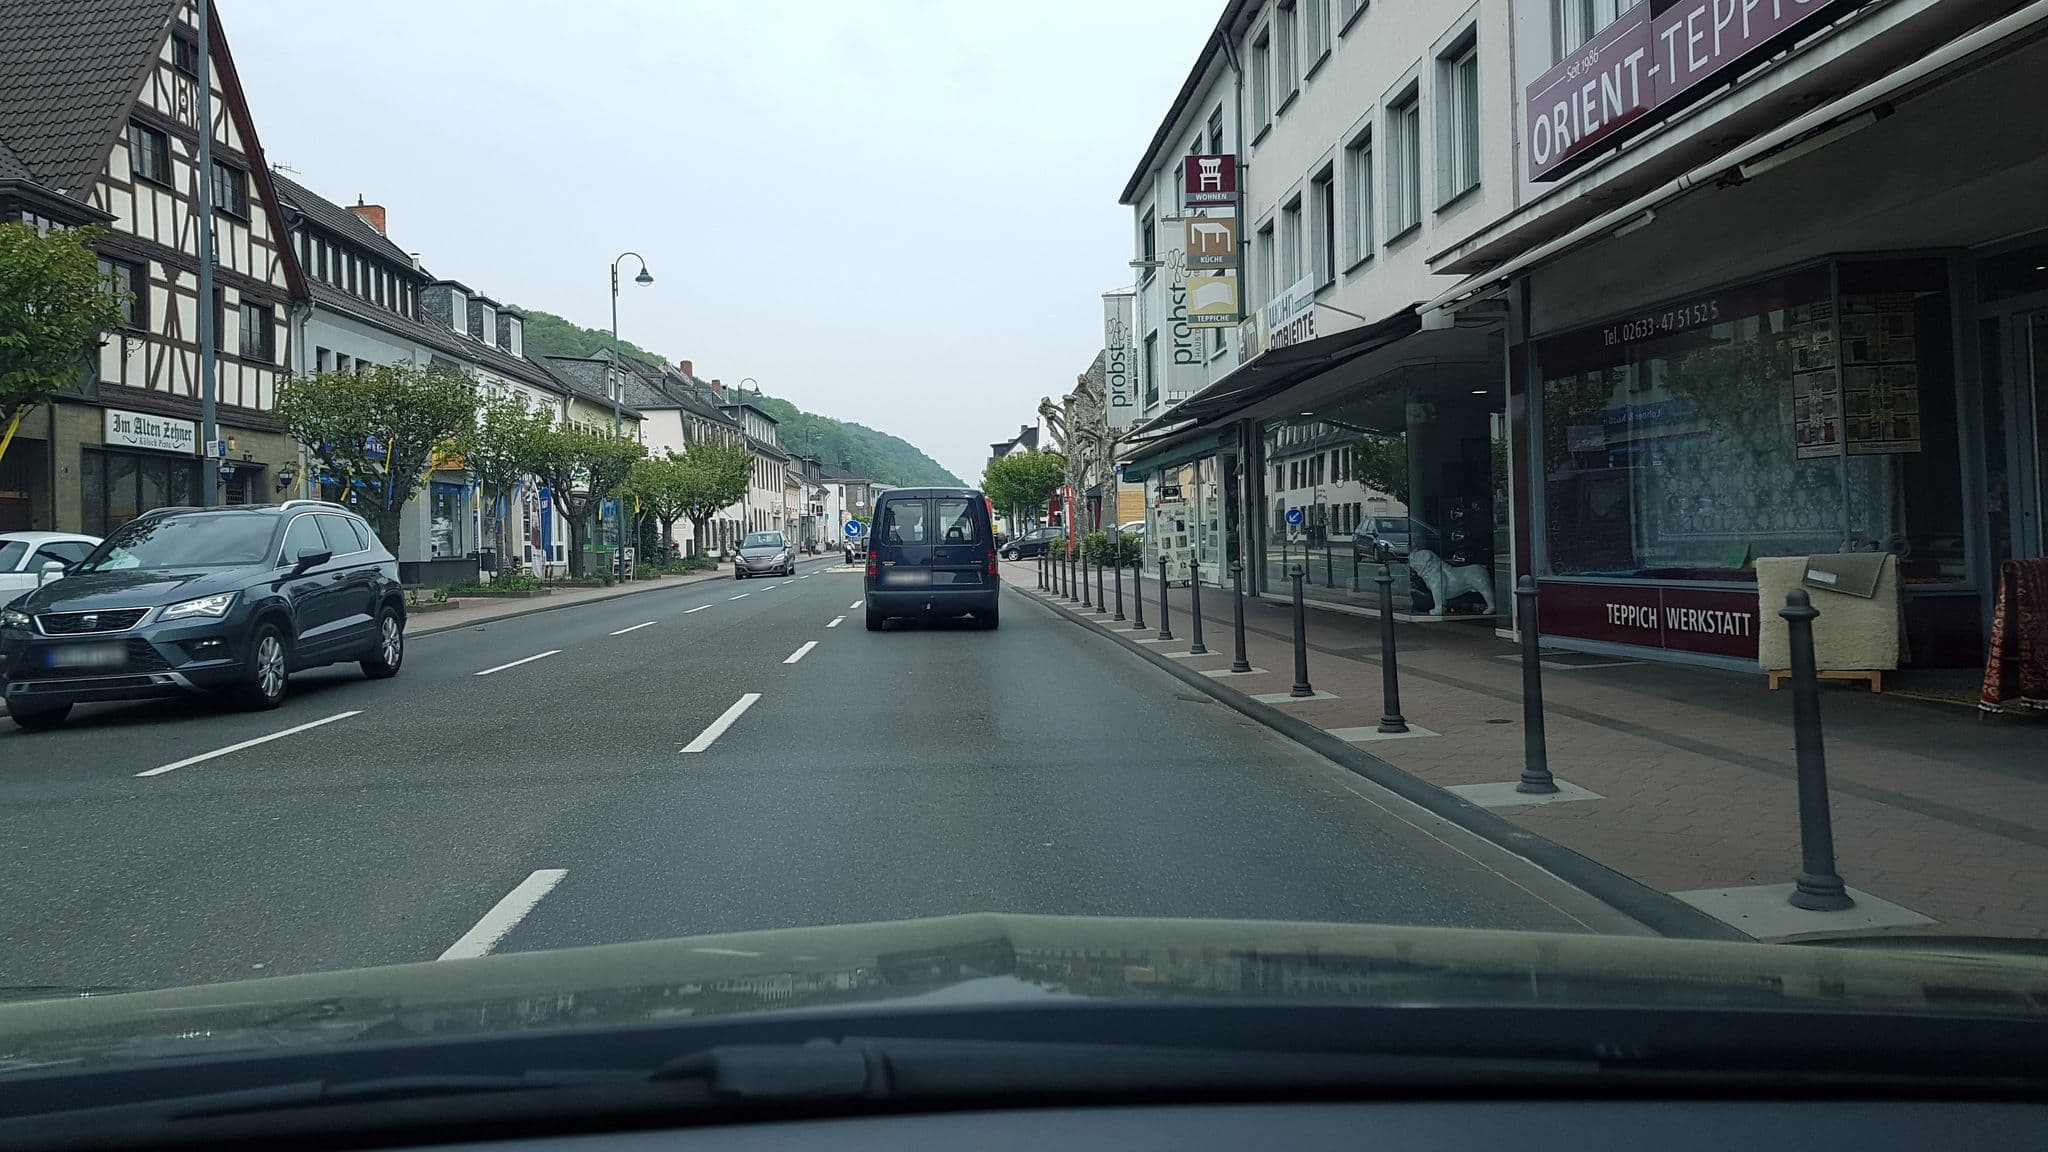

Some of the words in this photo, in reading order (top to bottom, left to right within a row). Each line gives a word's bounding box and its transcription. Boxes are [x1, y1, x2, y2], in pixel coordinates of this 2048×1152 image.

[1566, 61, 1581, 82] Seit
[1581, 46, 1599, 74] 1986
[1533, 0, 1813, 165] ORIENT-TEPP
[1195, 193, 1227, 201] WOHNEN
[1200, 254, 1223, 263] KÜCHE
[1197, 314, 1230, 322] TEPPICHE
[1603, 326, 1620, 346] Tel.
[1678, 307, 1690, 328] 51
[1107, 343, 1133, 407] probst
[113, 414, 131, 433] Im
[133, 416, 161, 438] Alten
[1606, 603, 1658, 629] TEPPICH
[1665, 606, 1751, 637] WERKSTATT
